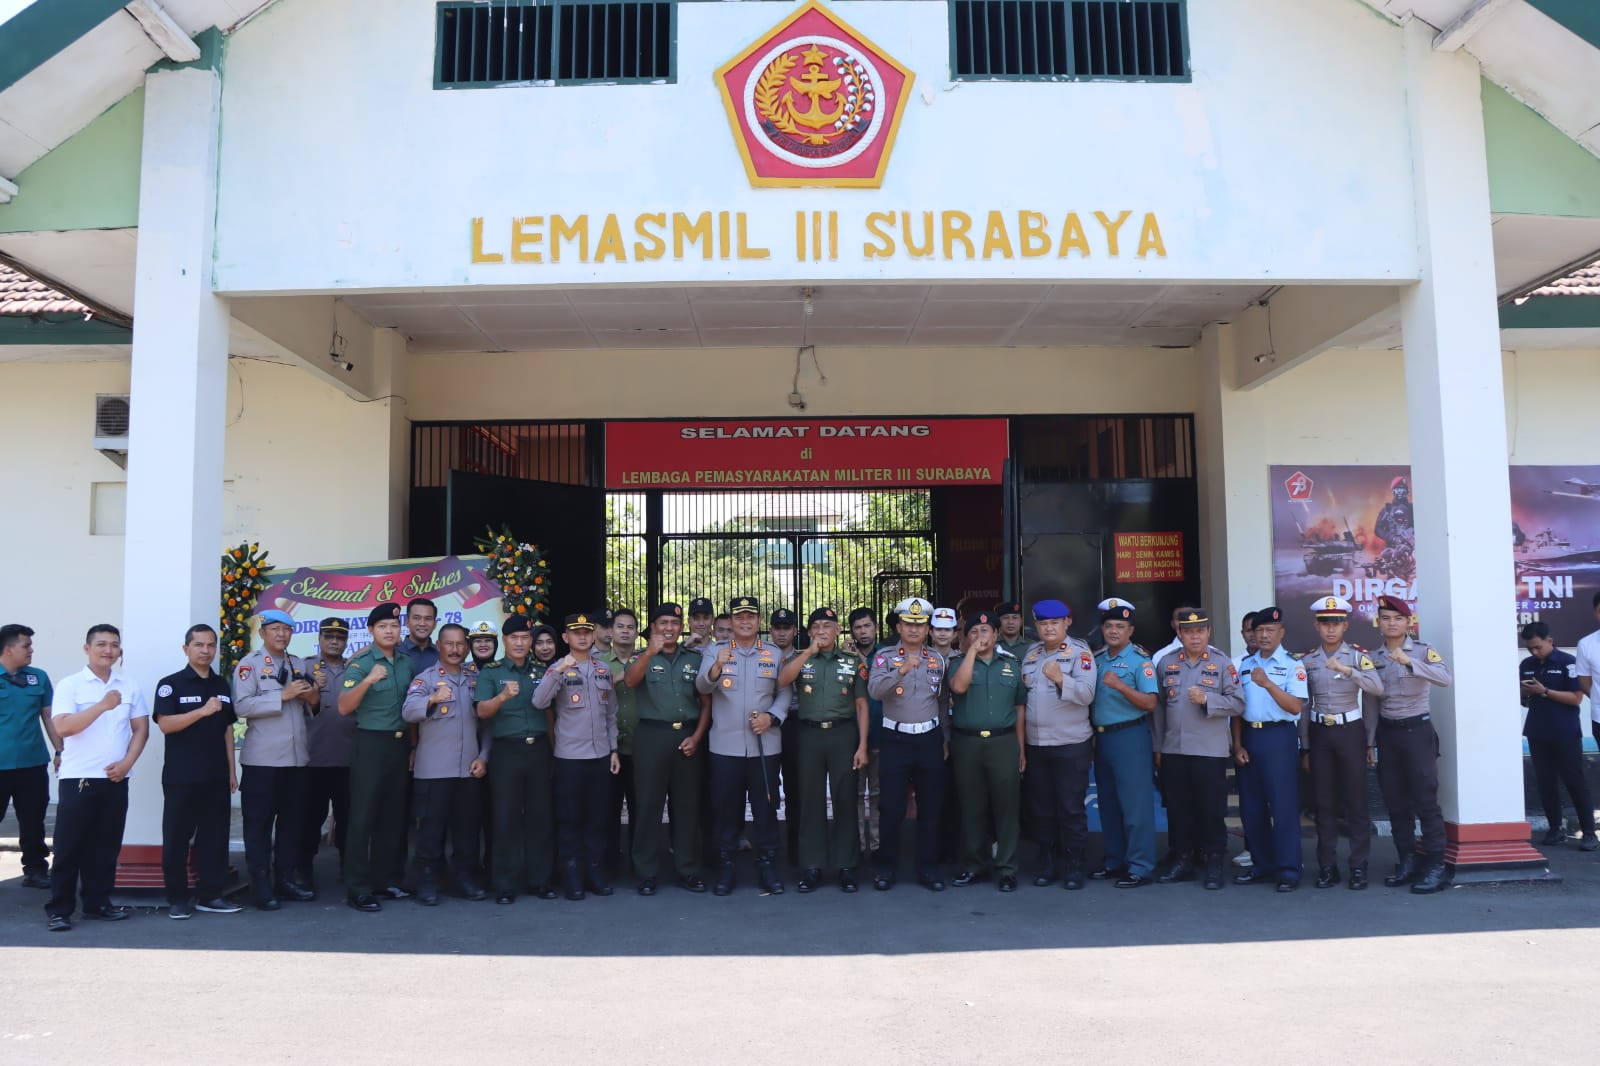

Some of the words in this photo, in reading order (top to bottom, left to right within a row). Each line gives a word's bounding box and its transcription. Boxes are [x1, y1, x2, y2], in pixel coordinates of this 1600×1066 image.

[472, 212, 770, 263] LEMASMIL
[796, 211, 838, 262] III
[864, 209, 1168, 260] SURABAYA
[680, 426, 810, 439] SELAMAT
[819, 425, 930, 437] DATANG
[800, 448, 812, 460] di
[622, 471, 691, 484] LEMBAGA
[695, 469, 830, 483] PEMASYARAKATAN
[834, 468, 892, 481] MILITER
[897, 468, 911, 480] III
[915, 467, 992, 480] SURABAYA
[1119, 535, 1139, 546] WAKTU
[1140, 535, 1178, 546] BERKUNJUNG
[1136, 560, 1152, 568] LIBUR
[1154, 560, 1181, 568] NASIONAL
[290, 577, 372, 603] Selamat
[376, 580, 396, 602] &
[402, 569, 461, 598] Sukses
[1521, 576, 1573, 598] TNI
[1534, 601, 1561, 609] 2023
[445, 611, 463, 623] 78
